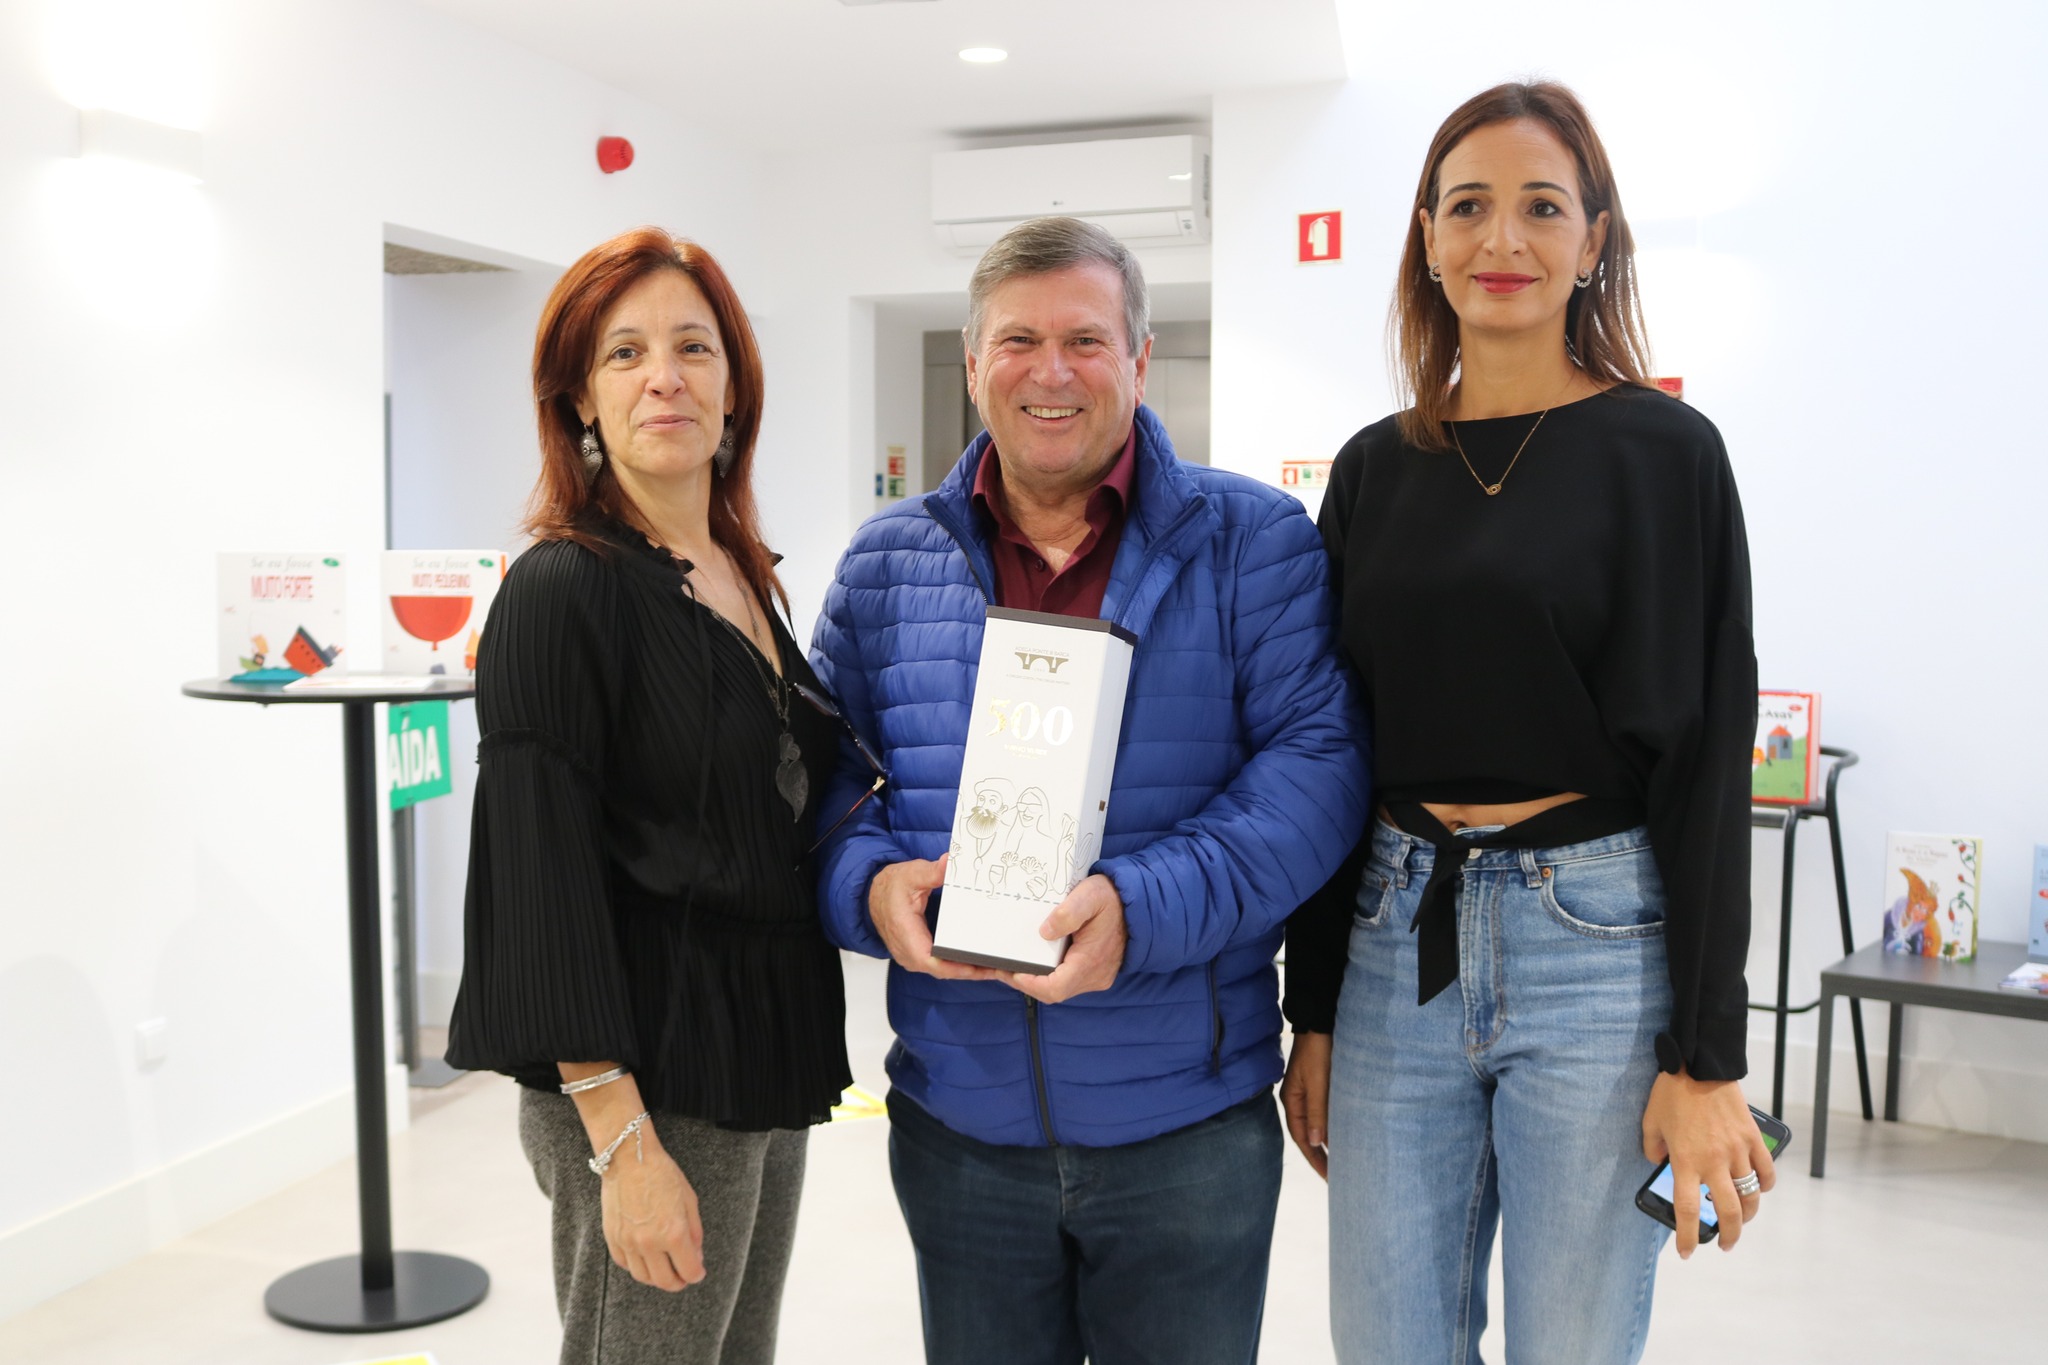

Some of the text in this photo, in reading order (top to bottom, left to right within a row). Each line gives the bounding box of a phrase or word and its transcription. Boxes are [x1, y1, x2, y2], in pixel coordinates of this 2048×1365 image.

[251, 575, 313, 599] MUITO FORTE
[985, 696, 1074, 746] 500
